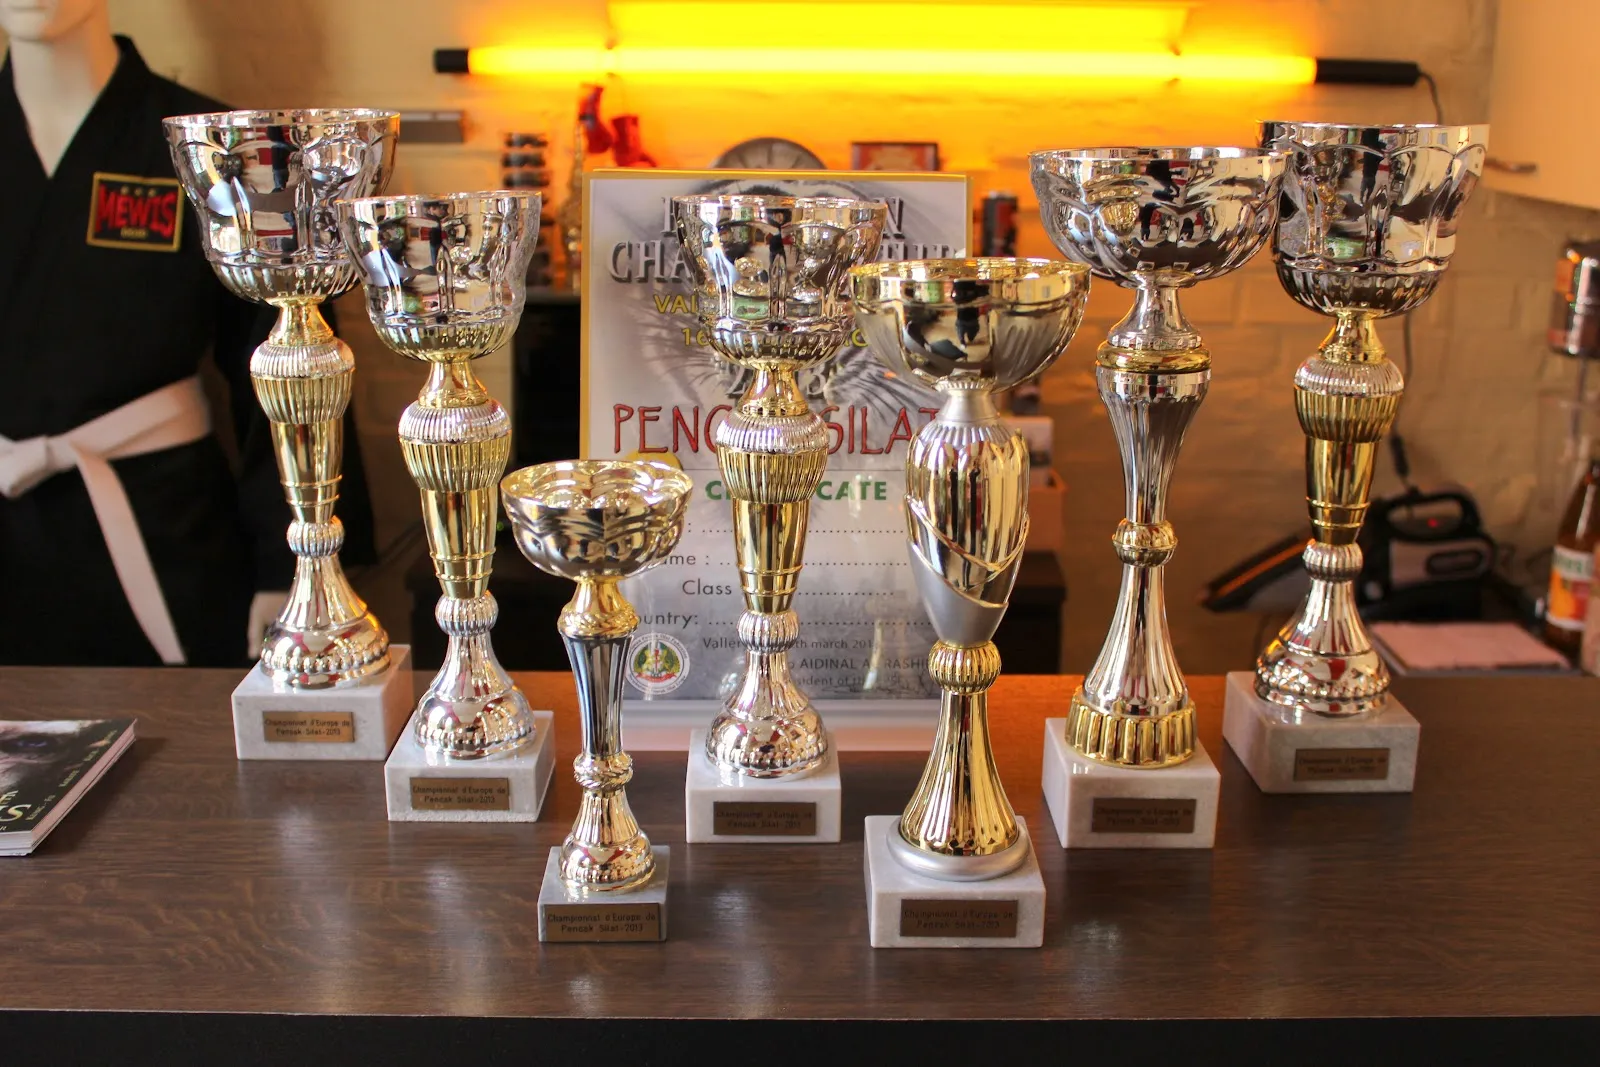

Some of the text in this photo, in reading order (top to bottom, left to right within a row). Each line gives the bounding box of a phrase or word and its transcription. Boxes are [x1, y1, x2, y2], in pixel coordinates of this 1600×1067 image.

[613, 403, 733, 454] PENC
[682, 578, 732, 596] Class
[811, 639, 848, 649] march
[852, 639, 874, 649] 201
[800, 658, 857, 669] AIDINAL
